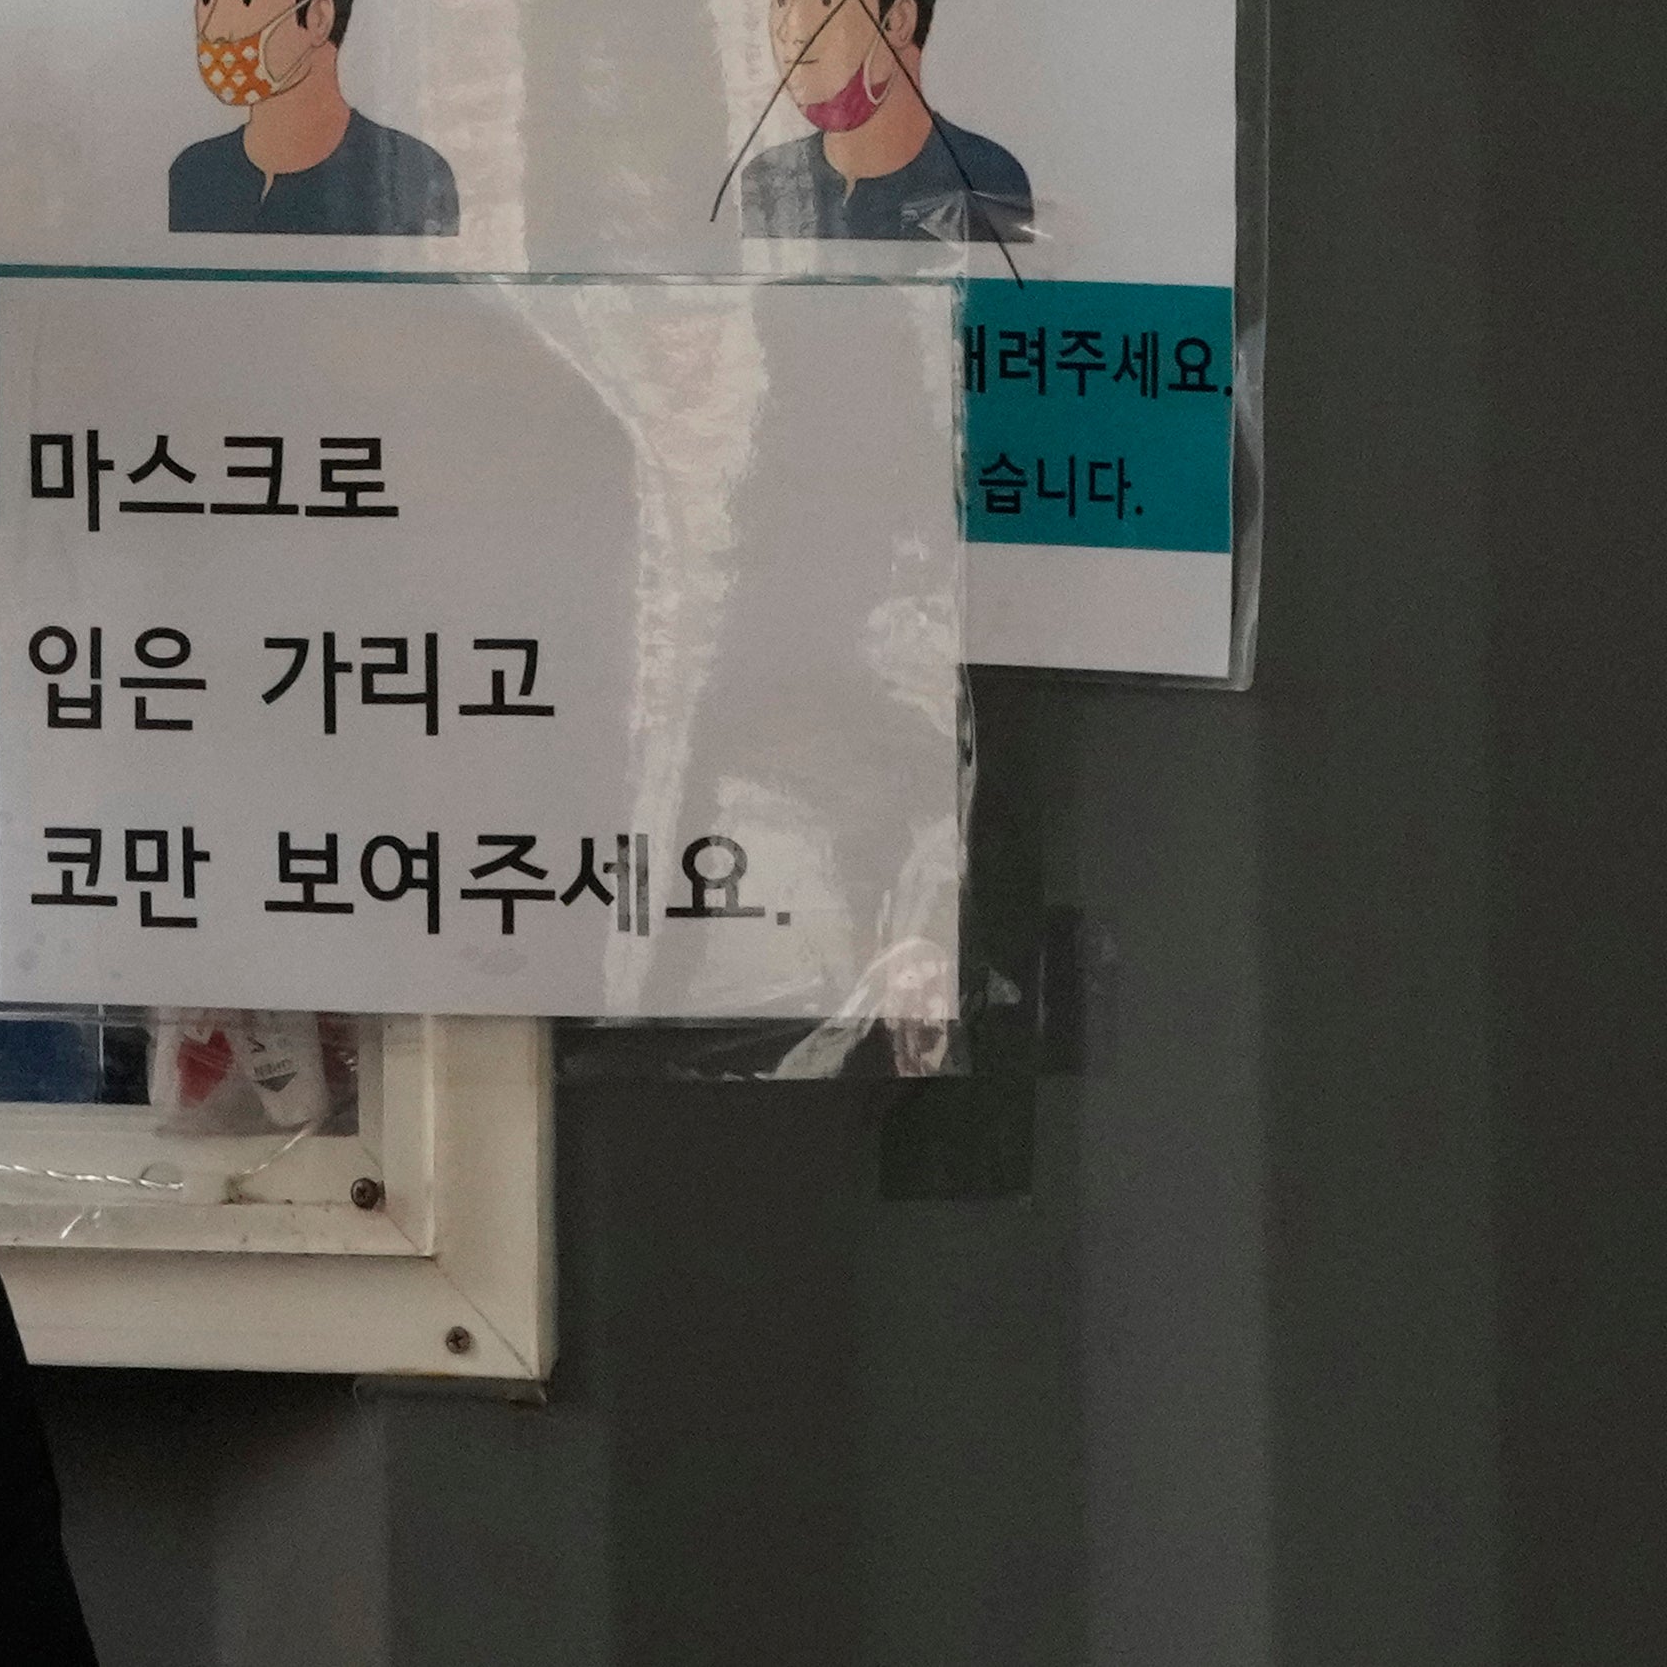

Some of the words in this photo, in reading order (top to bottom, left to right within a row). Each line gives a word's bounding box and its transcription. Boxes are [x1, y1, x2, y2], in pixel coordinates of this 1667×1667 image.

[29, 429, 400, 532] 마스크로
[965, 452, 1144, 520] 습니다.
[28, 625, 208, 732] 입은
[261, 631, 555, 735] 가리고
[29, 825, 211, 928] 코만
[263, 830, 795, 936] 보여주세요.
